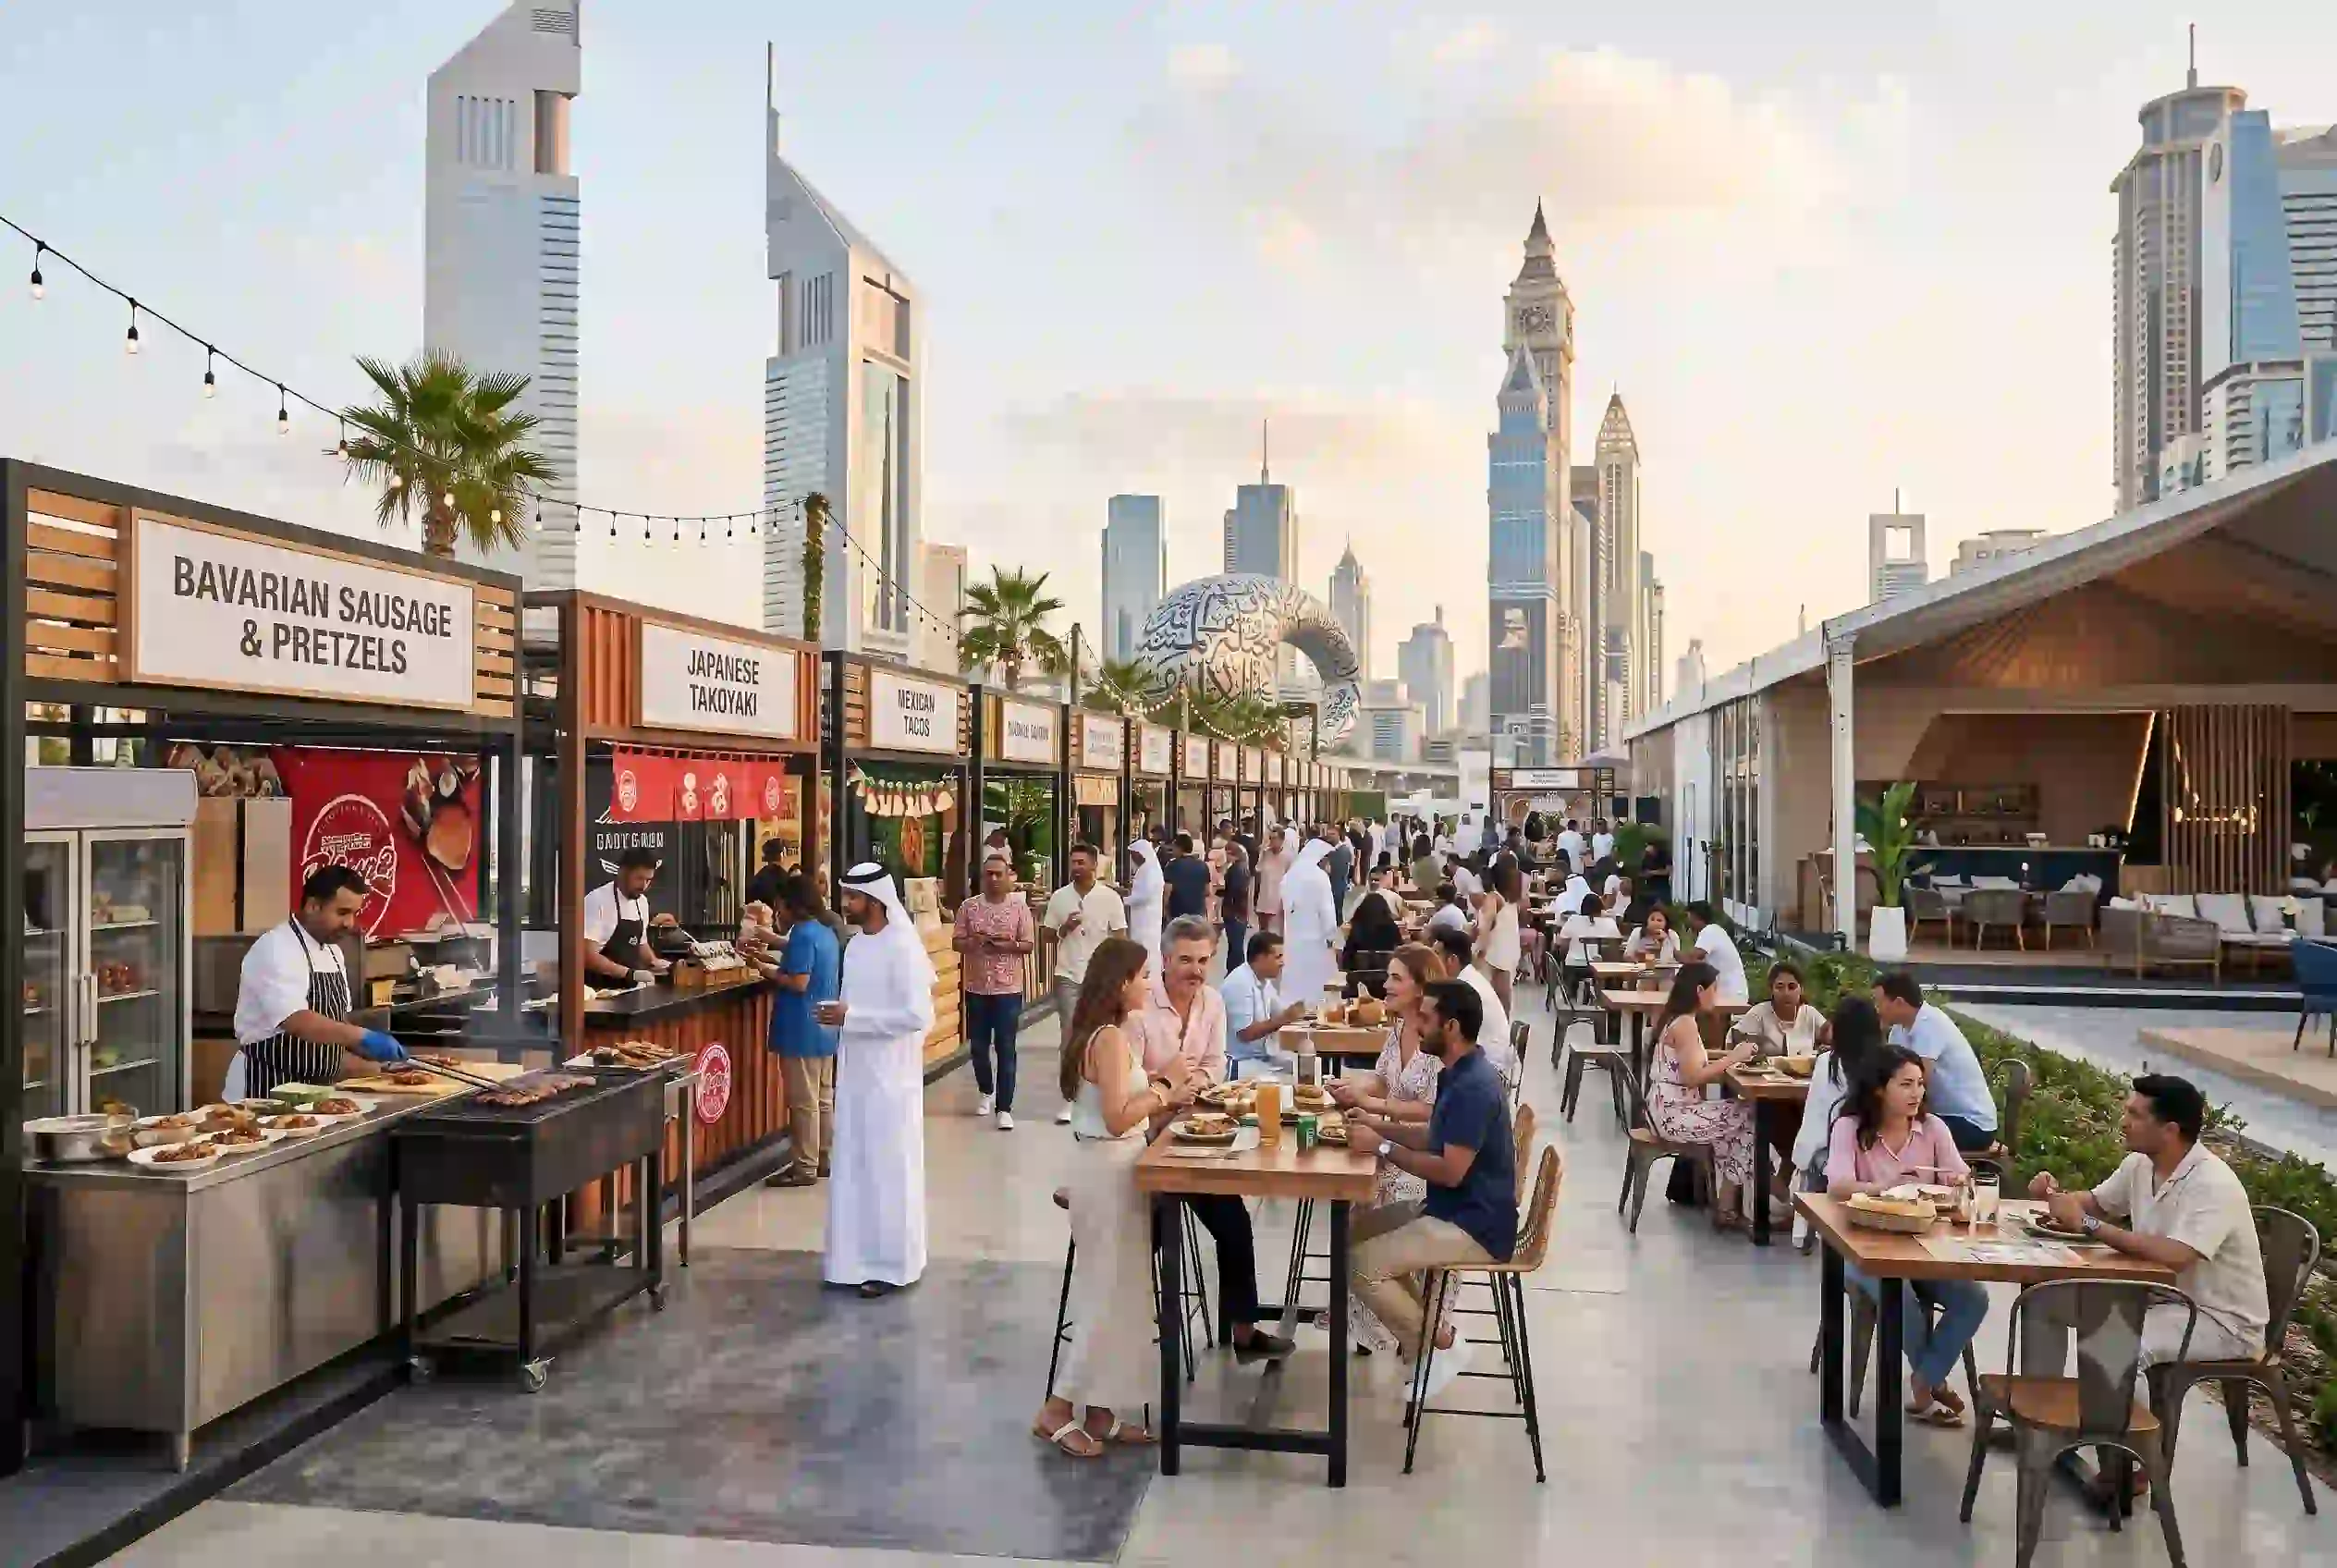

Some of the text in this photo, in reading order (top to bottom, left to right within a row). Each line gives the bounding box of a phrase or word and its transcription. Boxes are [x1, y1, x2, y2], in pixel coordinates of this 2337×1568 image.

[174, 556, 452, 638] BAVARIAN SAUSAGE
[240, 619, 407, 674] & PRETZELS
[687, 649, 760, 685] JAPANESE
[689, 683, 757, 717] TAKOYAKI
[898, 689, 936, 714] MEXICAN
[903, 715, 930, 737] TACOS
